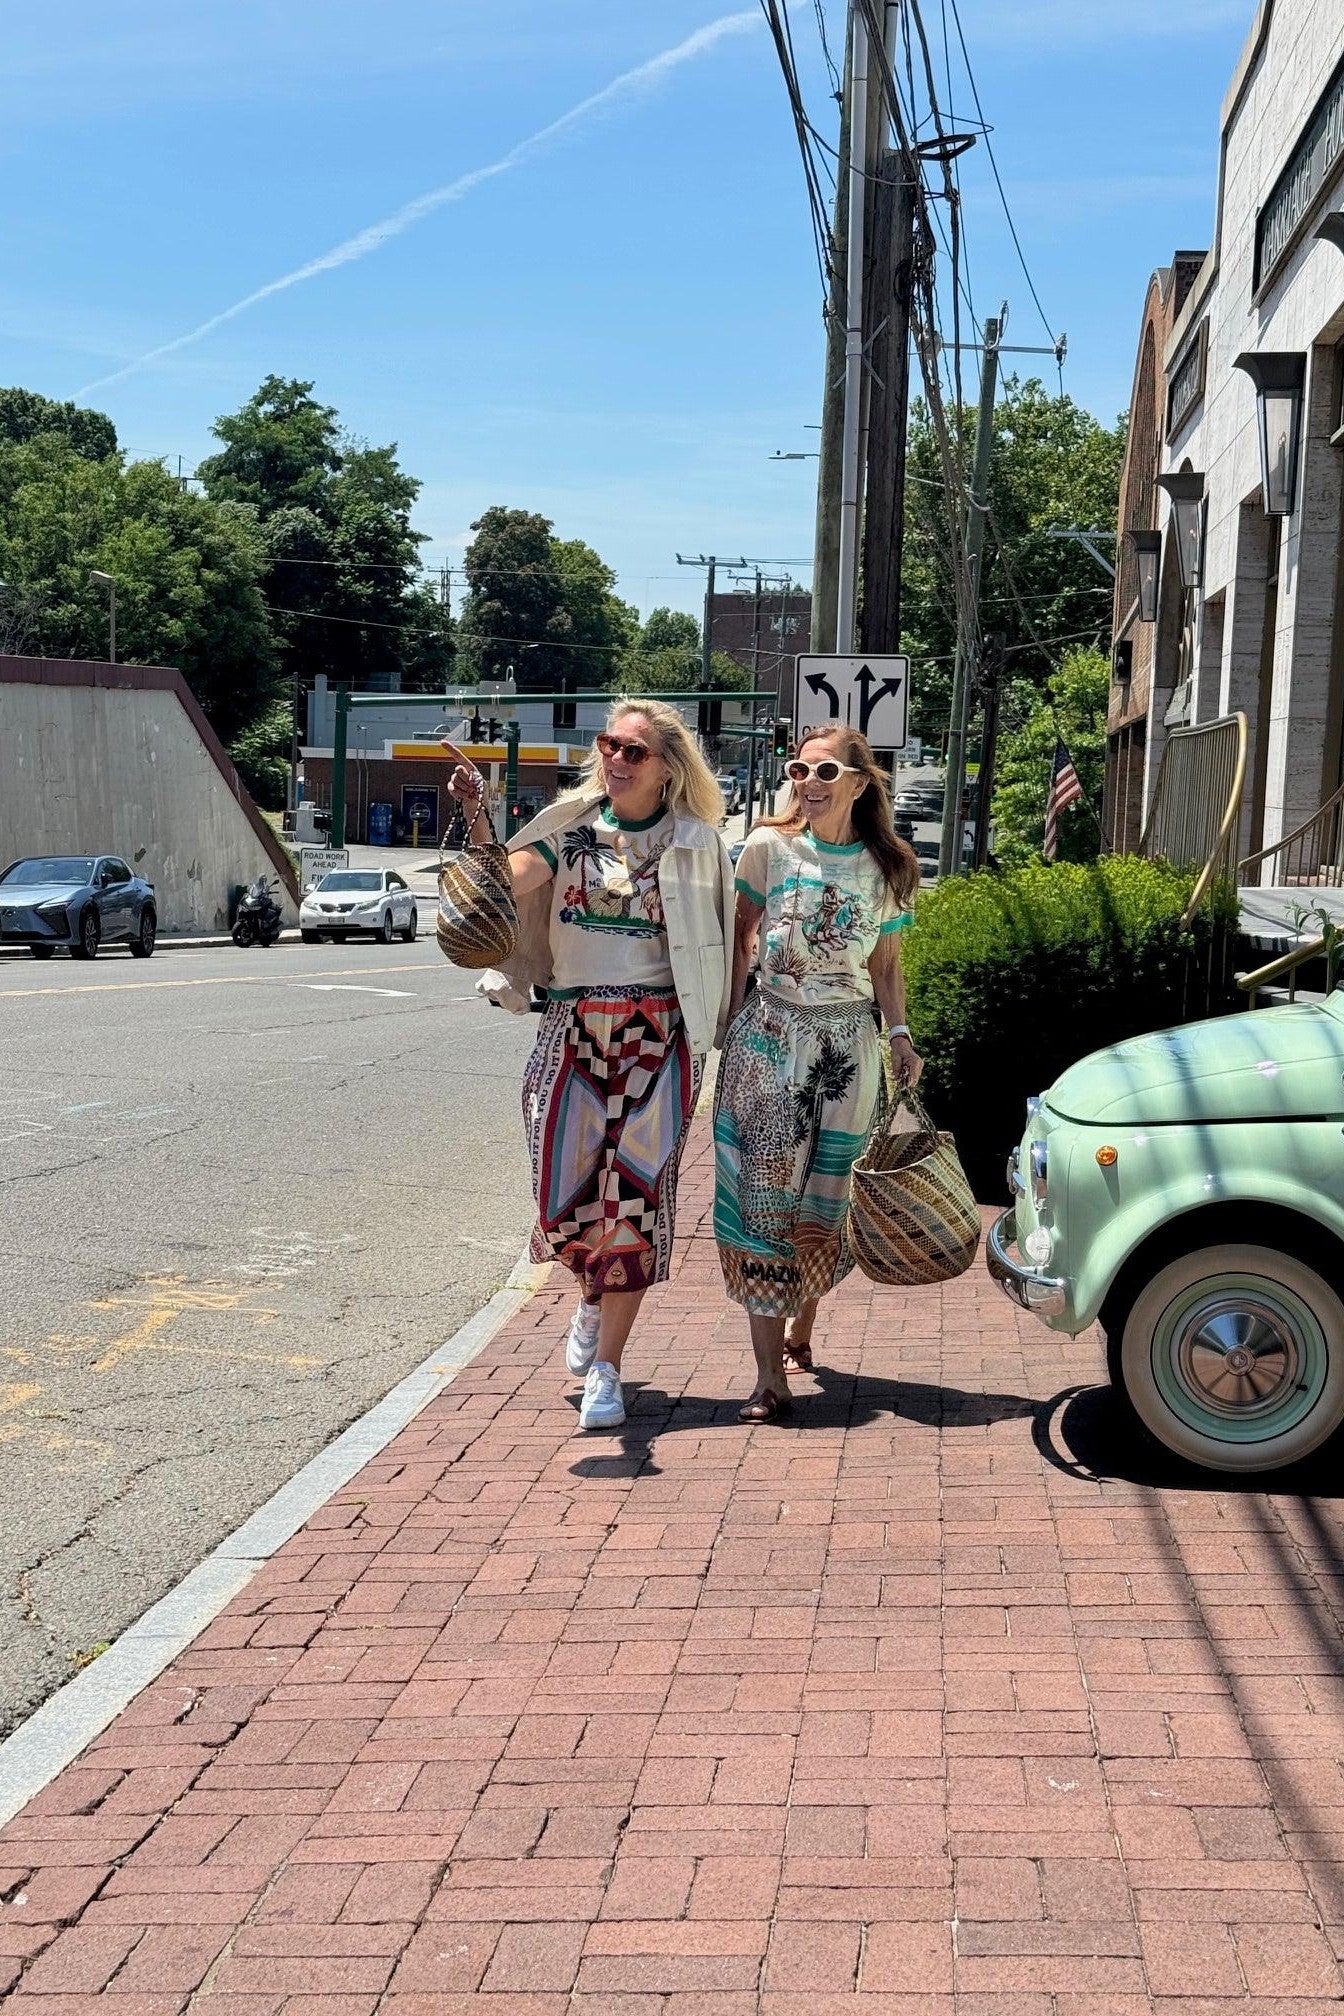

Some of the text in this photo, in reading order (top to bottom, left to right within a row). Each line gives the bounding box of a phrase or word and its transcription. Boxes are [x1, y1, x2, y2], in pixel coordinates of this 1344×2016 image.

[304, 852, 346, 861] ROAD WORK
[312, 861, 337, 869] AHEAD
[552, 1031, 564, 1054] FOR
[551, 1055, 560, 1067] IT
[545, 1069, 557, 1086] DO
[537, 1089, 549, 1113] YOU
[533, 1117, 542, 1141] FOR
[532, 1142, 540, 1155] IT
[532, 1157, 539, 1175] DO
[659, 1212, 666, 1229] DO
[660, 1233, 668, 1260] YOU
